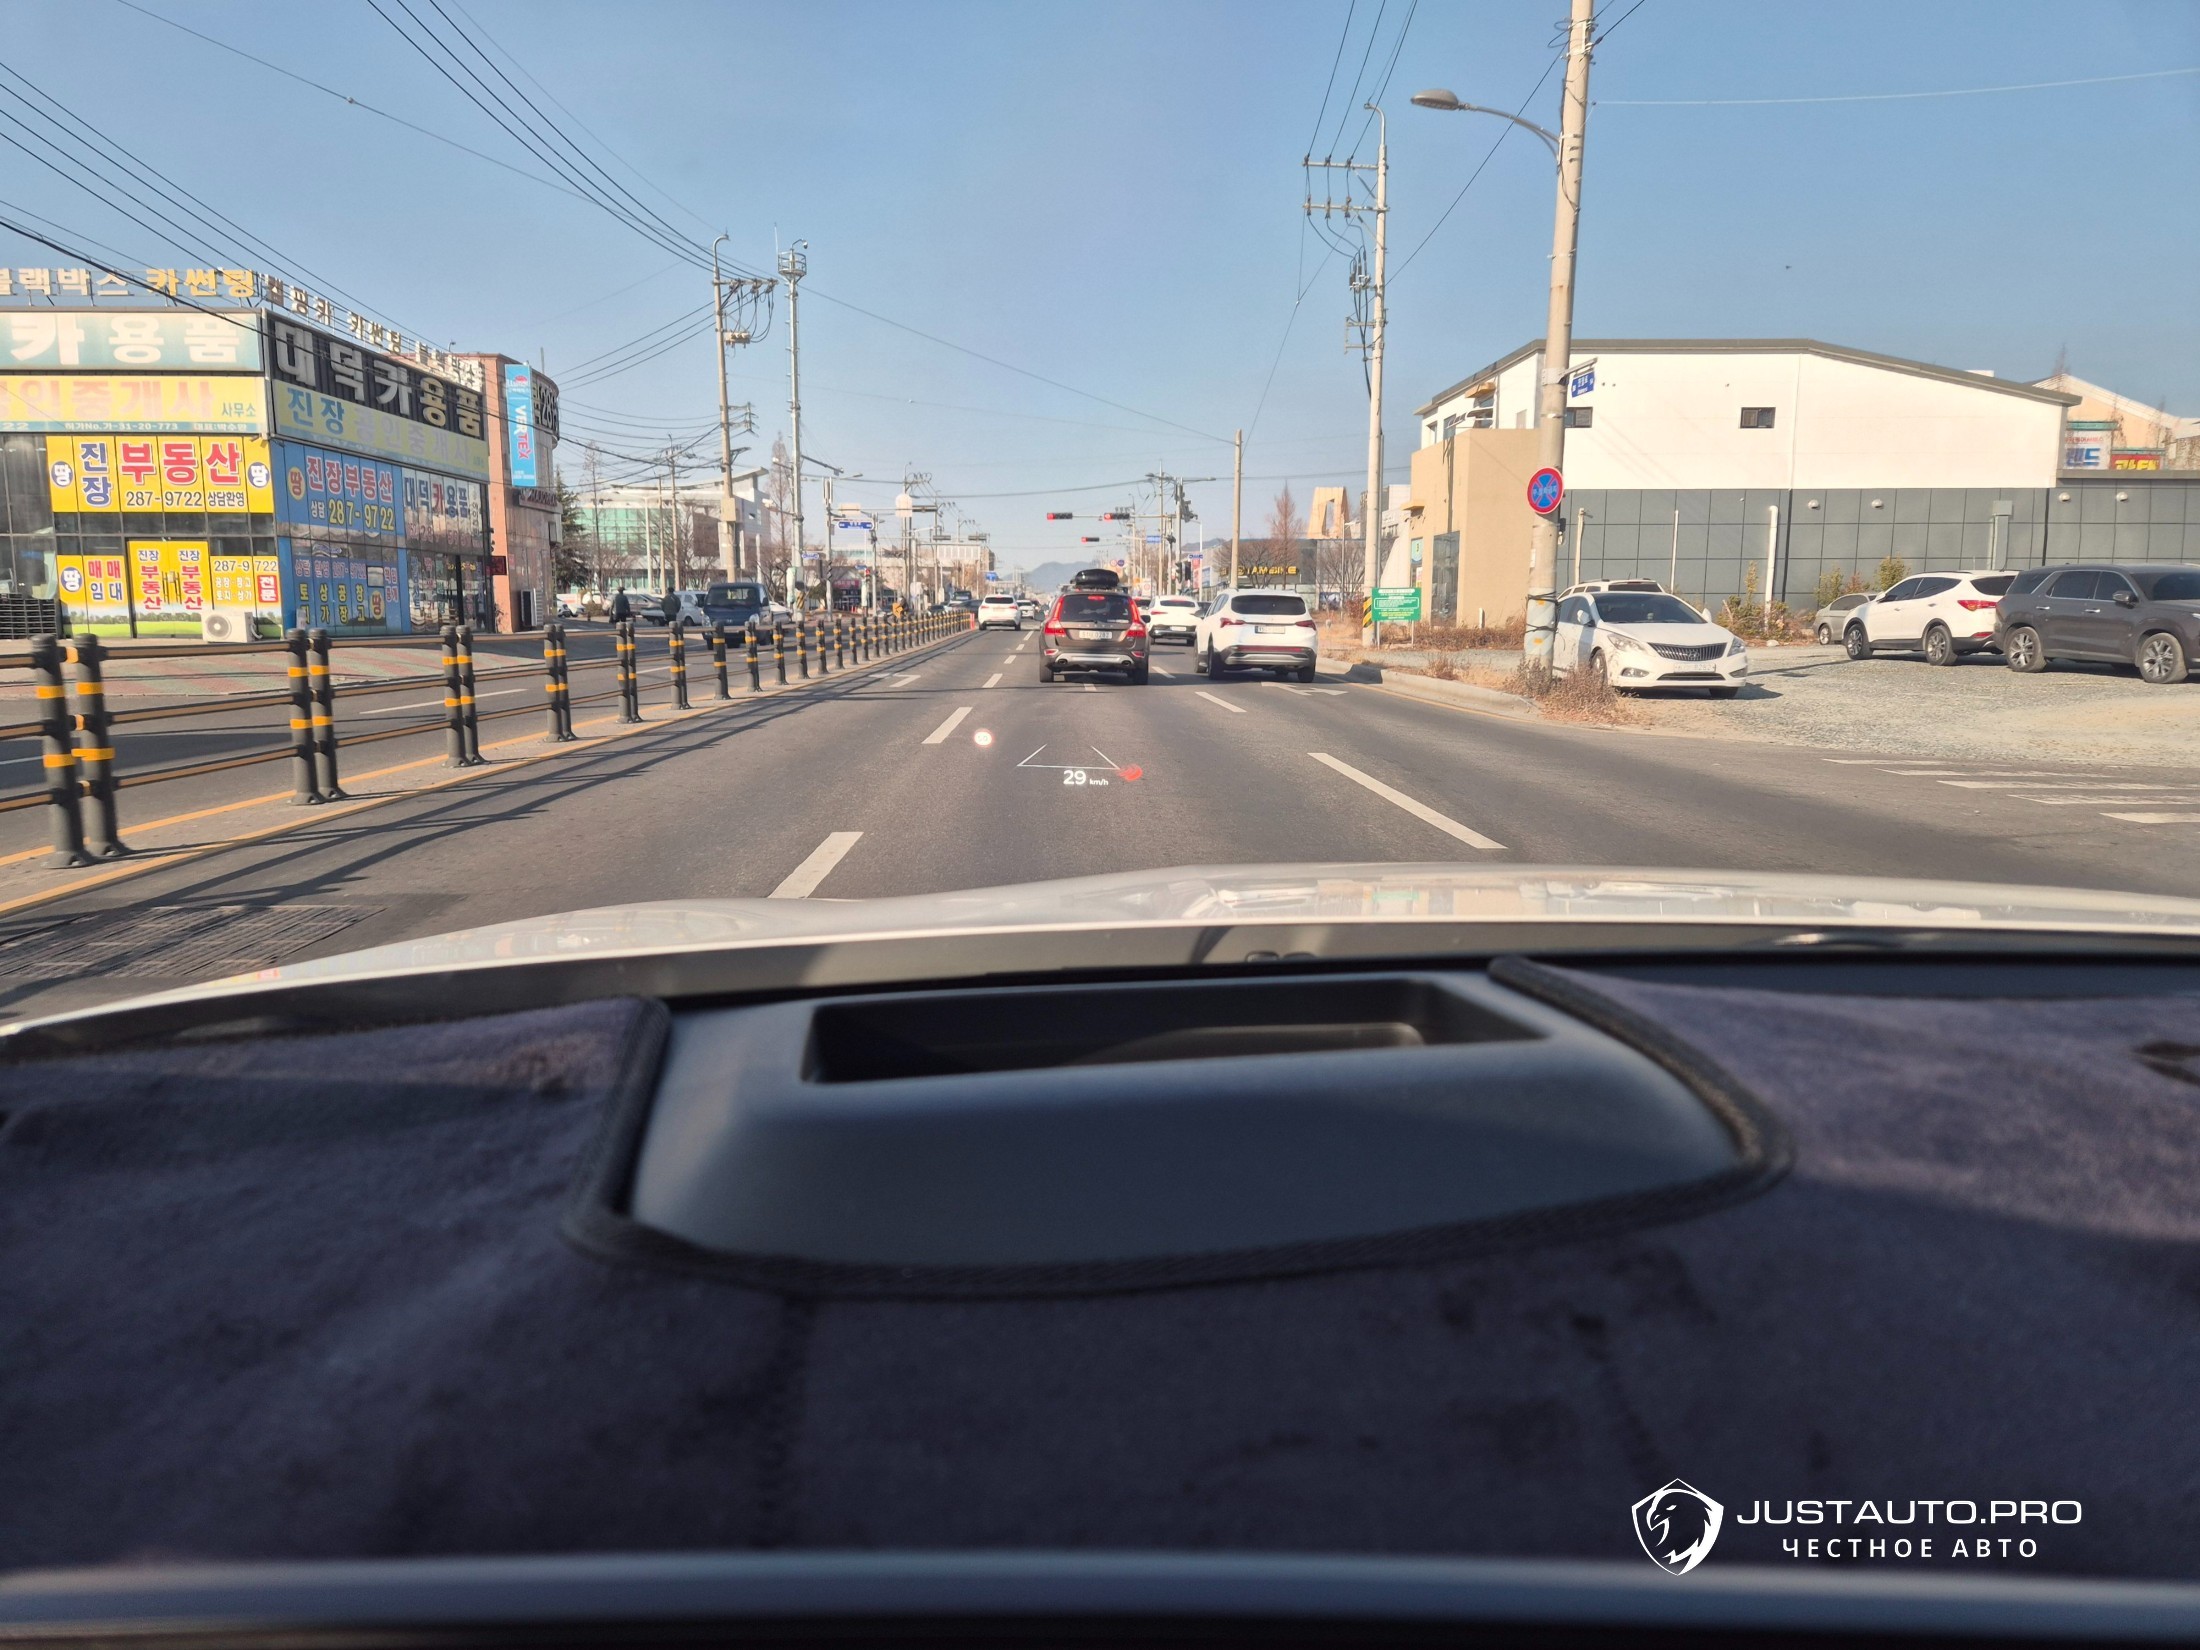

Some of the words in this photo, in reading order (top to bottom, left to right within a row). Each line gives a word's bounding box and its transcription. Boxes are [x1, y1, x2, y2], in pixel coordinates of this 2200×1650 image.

[147, 268, 255, 297] 카썬팅
[11, 314, 240, 366] 카용품
[0, 380, 215, 420] 인중개사
[221, 402, 256, 417] 사무소
[274, 320, 486, 440] 대덕카용품
[287, 387, 345, 435] 진장
[513, 404, 532, 460] VERTEX
[81, 441, 113, 507] 진장
[121, 442, 244, 486] 부동산
[306, 455, 393, 503] 진장부동산
[126, 490, 203, 508] 287-9722
[207, 491, 245, 508] 상담환영
[311, 500, 325, 519] 상담
[328, 498, 395, 532] 287-9722
[404, 477, 468, 519] 대덕카용품
[88, 559, 121, 578] 매매
[138, 550, 159, 561] 진장
[178, 550, 200, 561] 진장
[214, 560, 277, 571] 287-9722
[90, 582, 123, 601] 임대
[141, 565, 163, 610] 부동산
[181, 565, 203, 610] 부동산
[319, 583, 330, 624] 상가
[338, 584, 348, 624] 공장
[356, 584, 366, 623] 창고
[1063, 770, 1087, 785] 29
[1089, 778, 1109, 786] km/h
